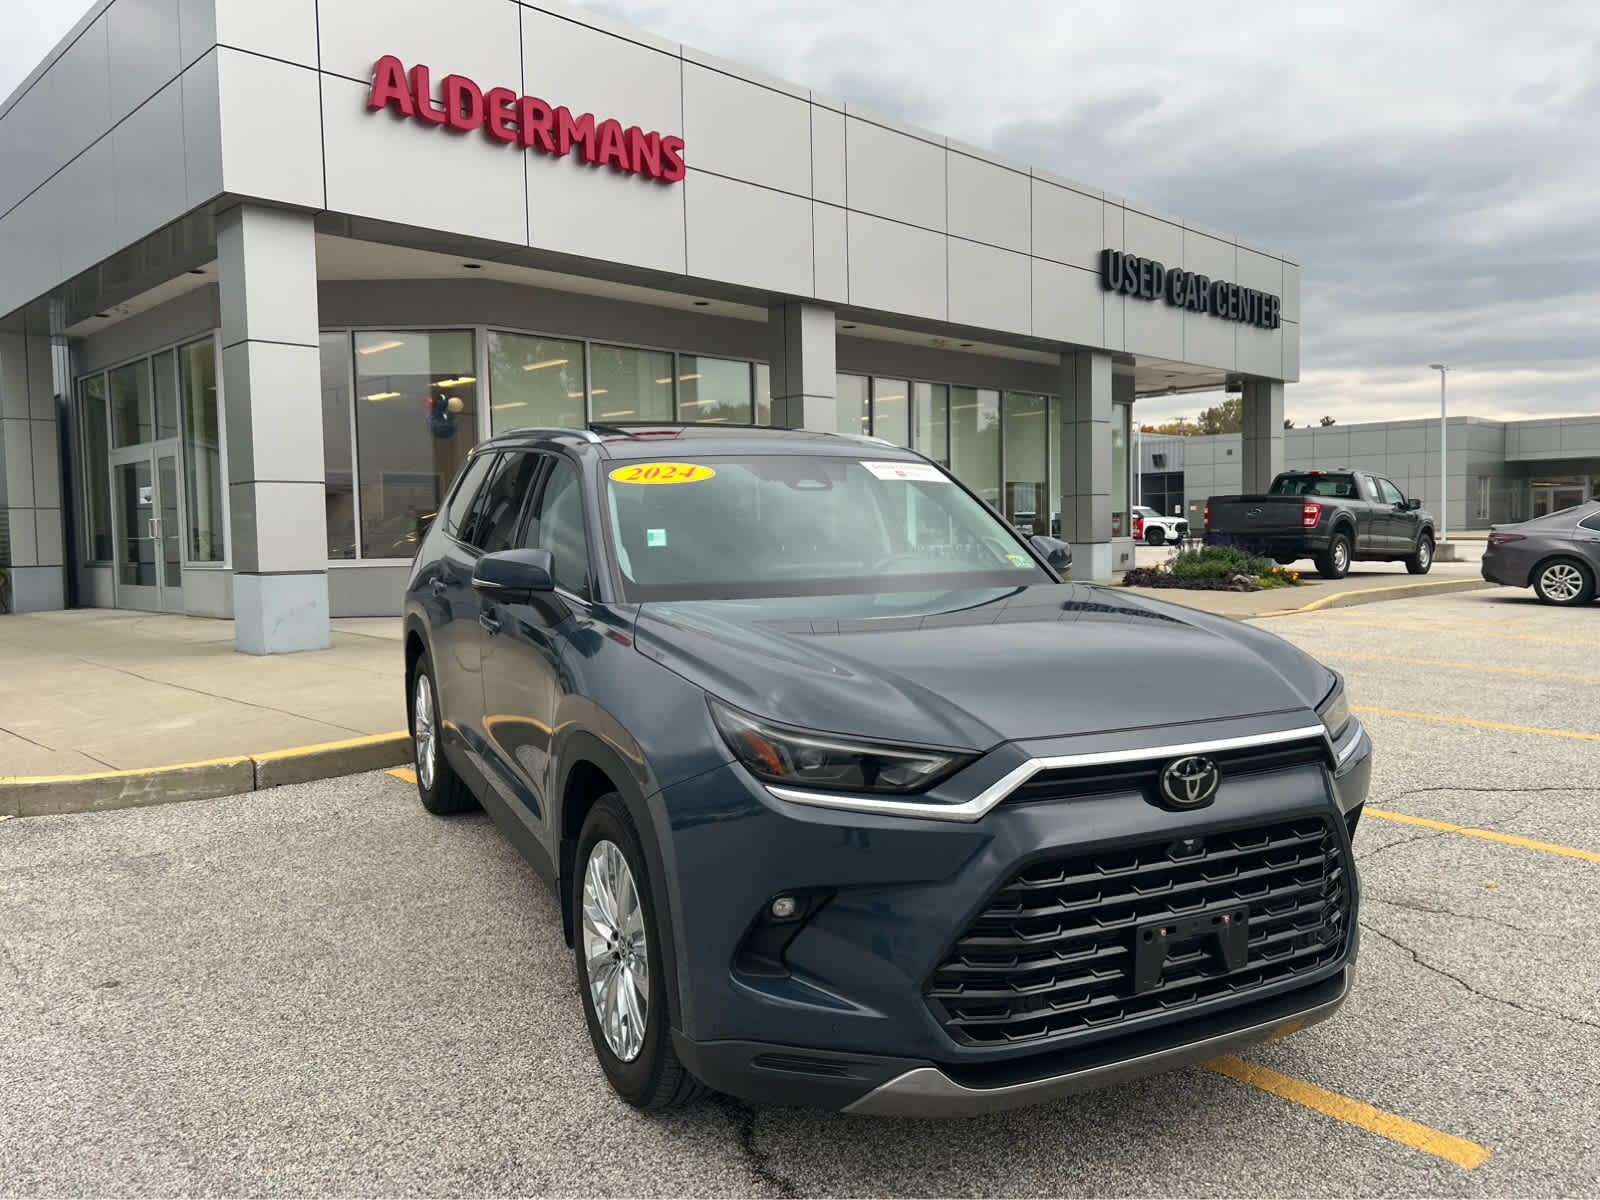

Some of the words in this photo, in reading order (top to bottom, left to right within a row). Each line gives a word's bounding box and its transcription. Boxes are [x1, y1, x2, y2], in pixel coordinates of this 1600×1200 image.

[366, 55, 686, 184] ALDERMANS
[1102, 249, 1166, 299] USED
[1168, 267, 1211, 313] CAR
[1211, 280, 1281, 329] CENTER
[624, 466, 697, 481] 2024
